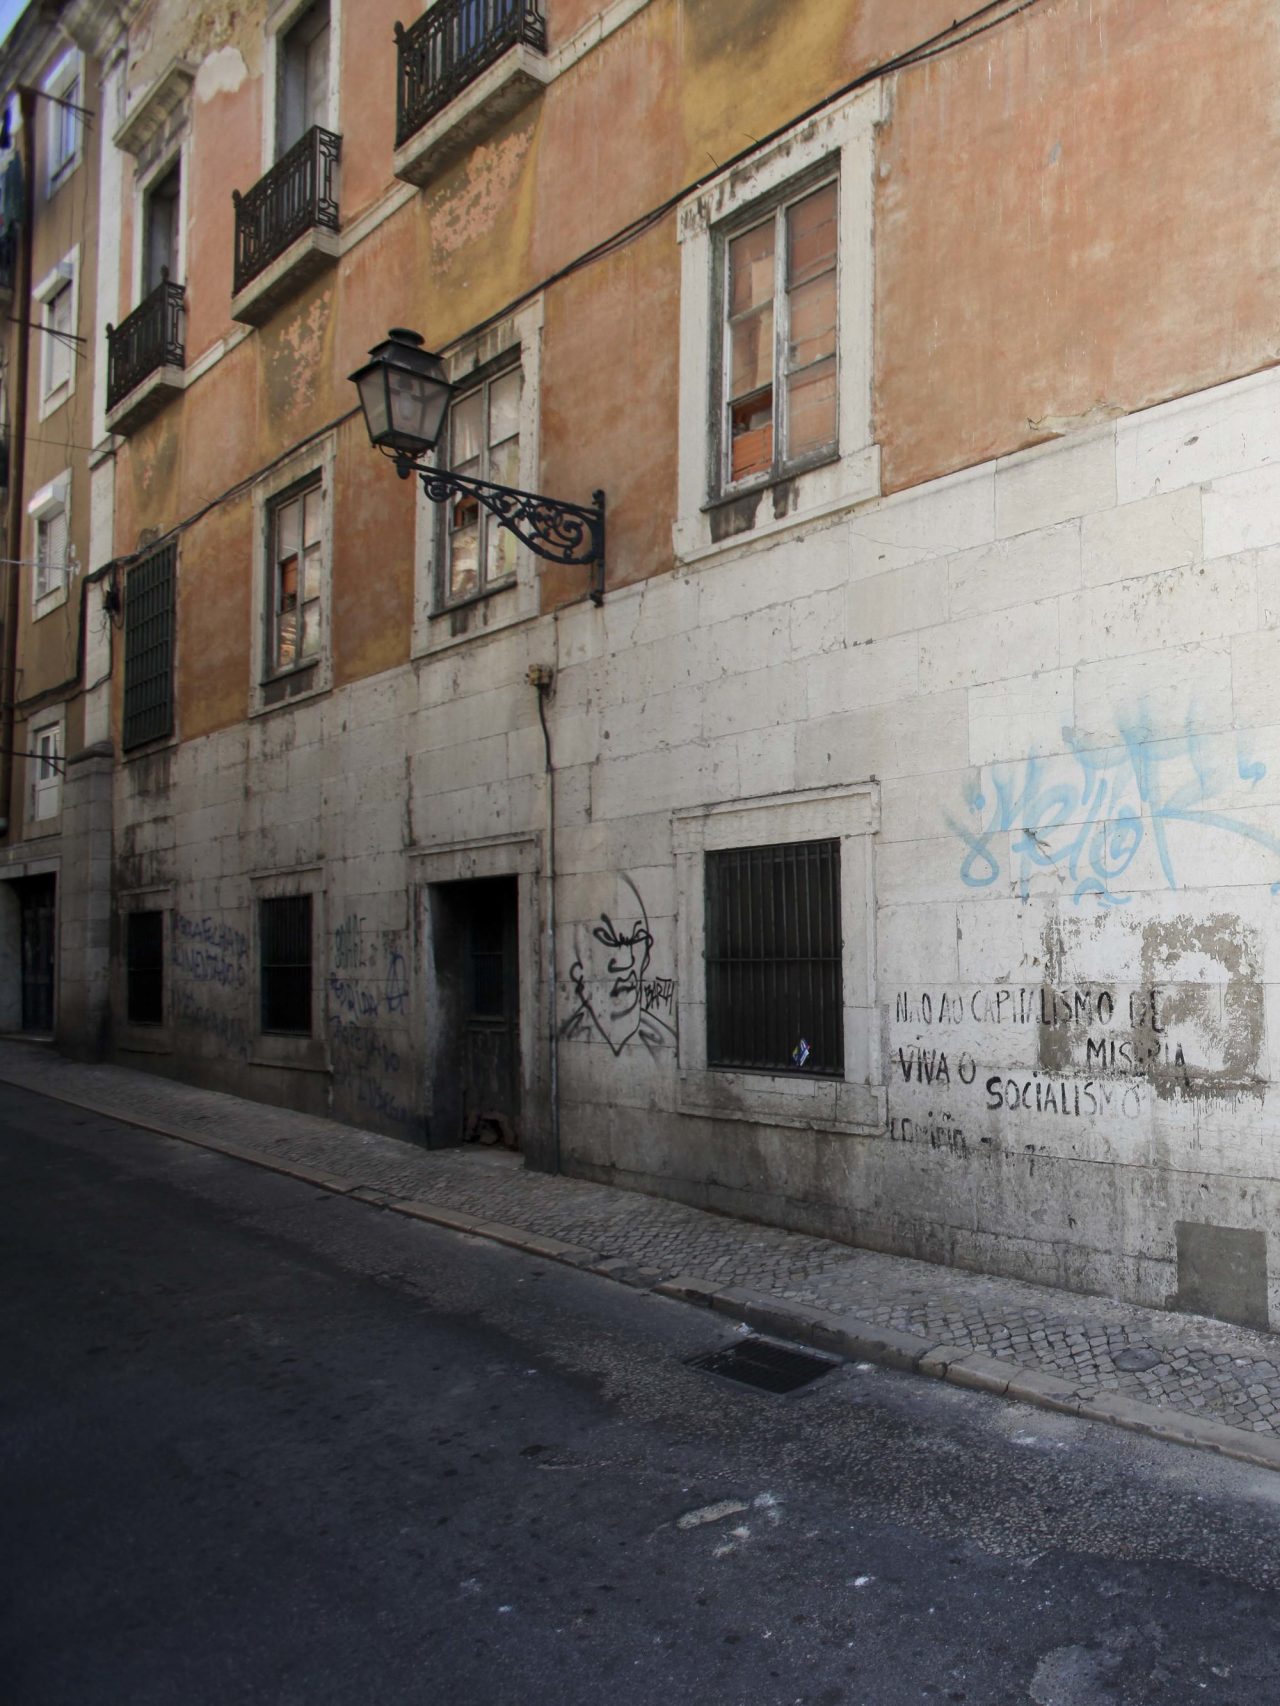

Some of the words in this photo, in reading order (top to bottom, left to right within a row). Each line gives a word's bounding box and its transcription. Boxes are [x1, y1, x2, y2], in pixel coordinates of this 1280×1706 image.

[898, 1046, 951, 1086] VIVA
[958, 1051, 977, 1085] O
[986, 1073, 1141, 1119] SOCIALISMO
